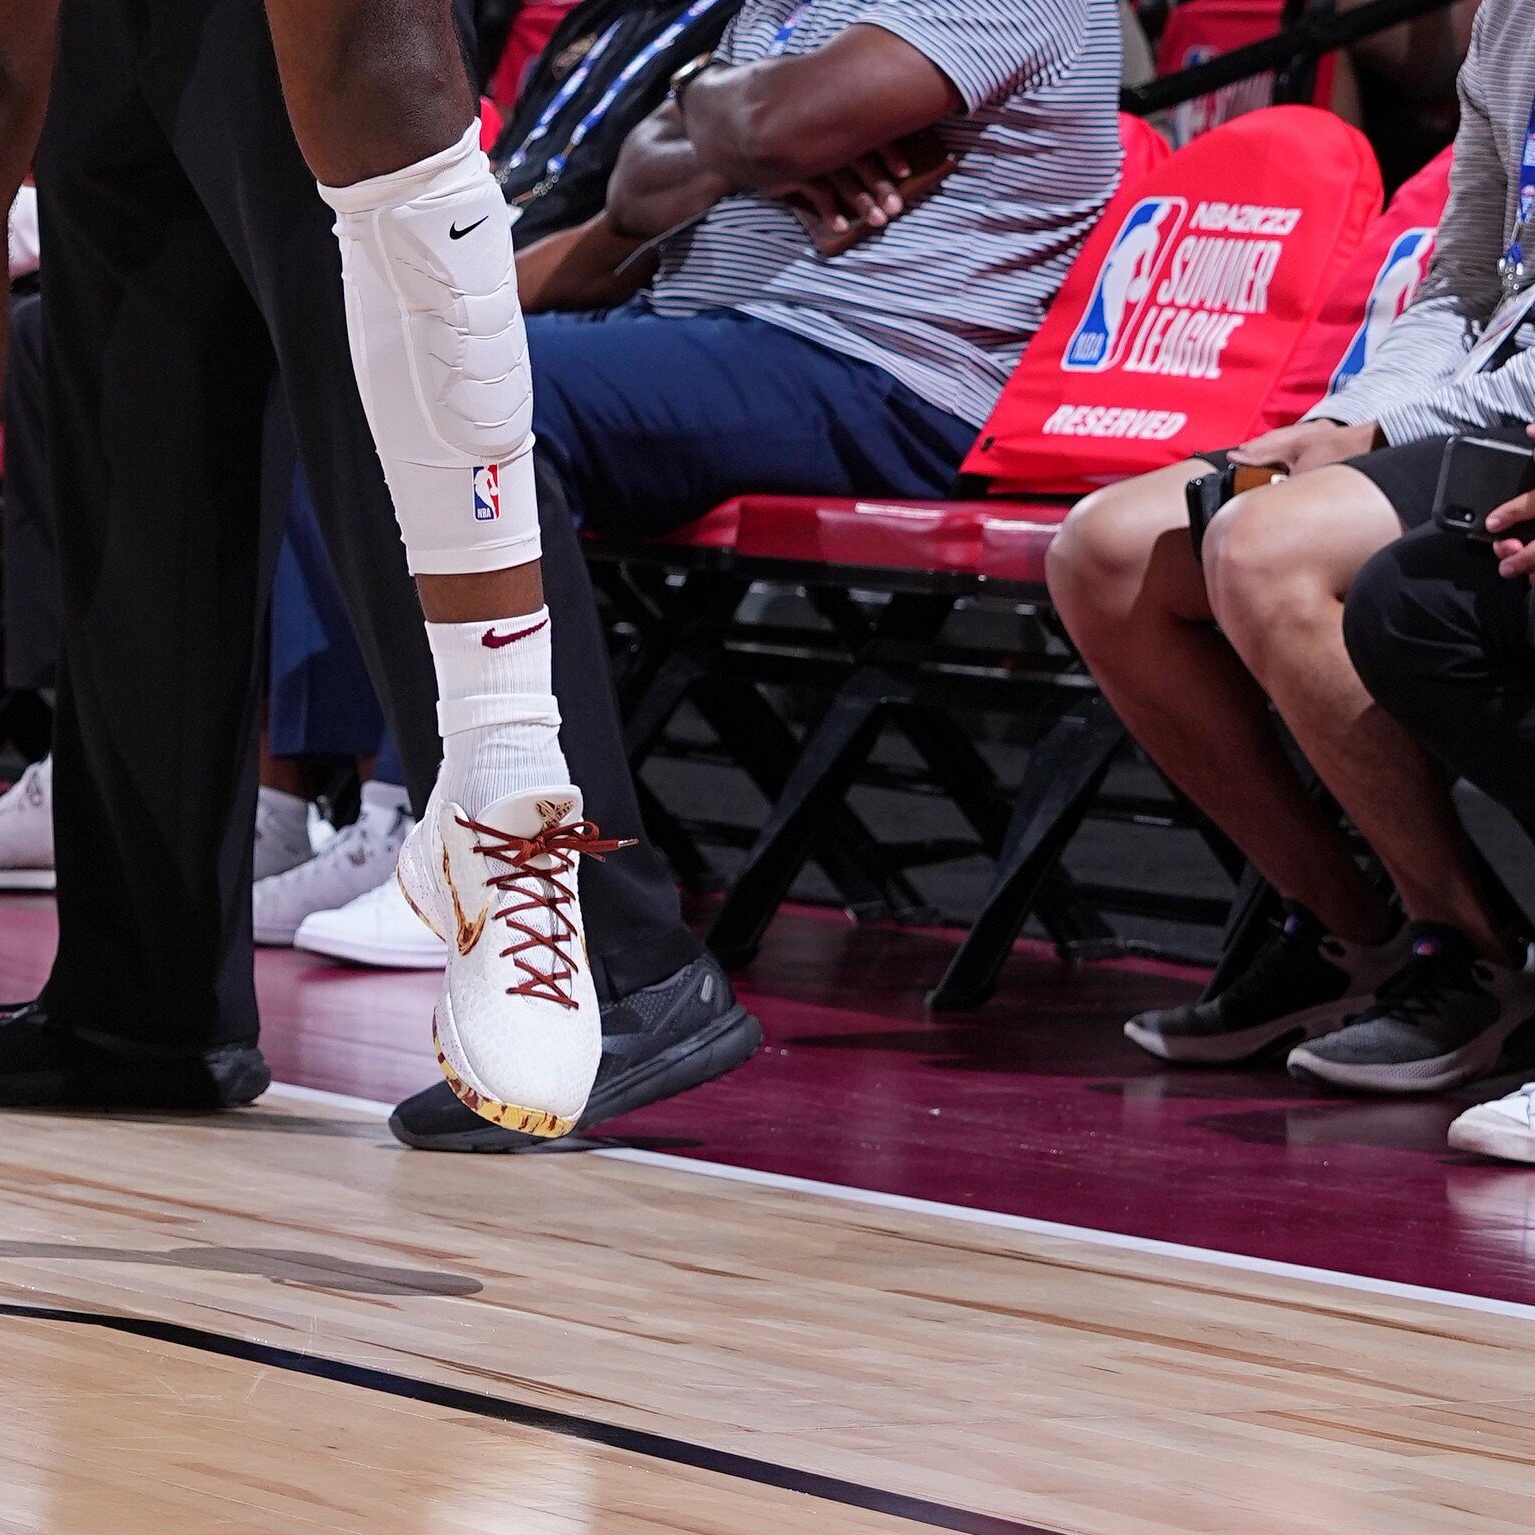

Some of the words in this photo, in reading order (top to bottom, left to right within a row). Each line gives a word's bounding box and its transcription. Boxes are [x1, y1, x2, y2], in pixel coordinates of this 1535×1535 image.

[1189, 201, 1303, 236] NBA2K23
[1155, 235, 1283, 313] SUMMER
[1121, 305, 1245, 380] LEAGUE
[1042, 404, 1188, 441] RESERVED
[477, 507, 491, 518] NBA
